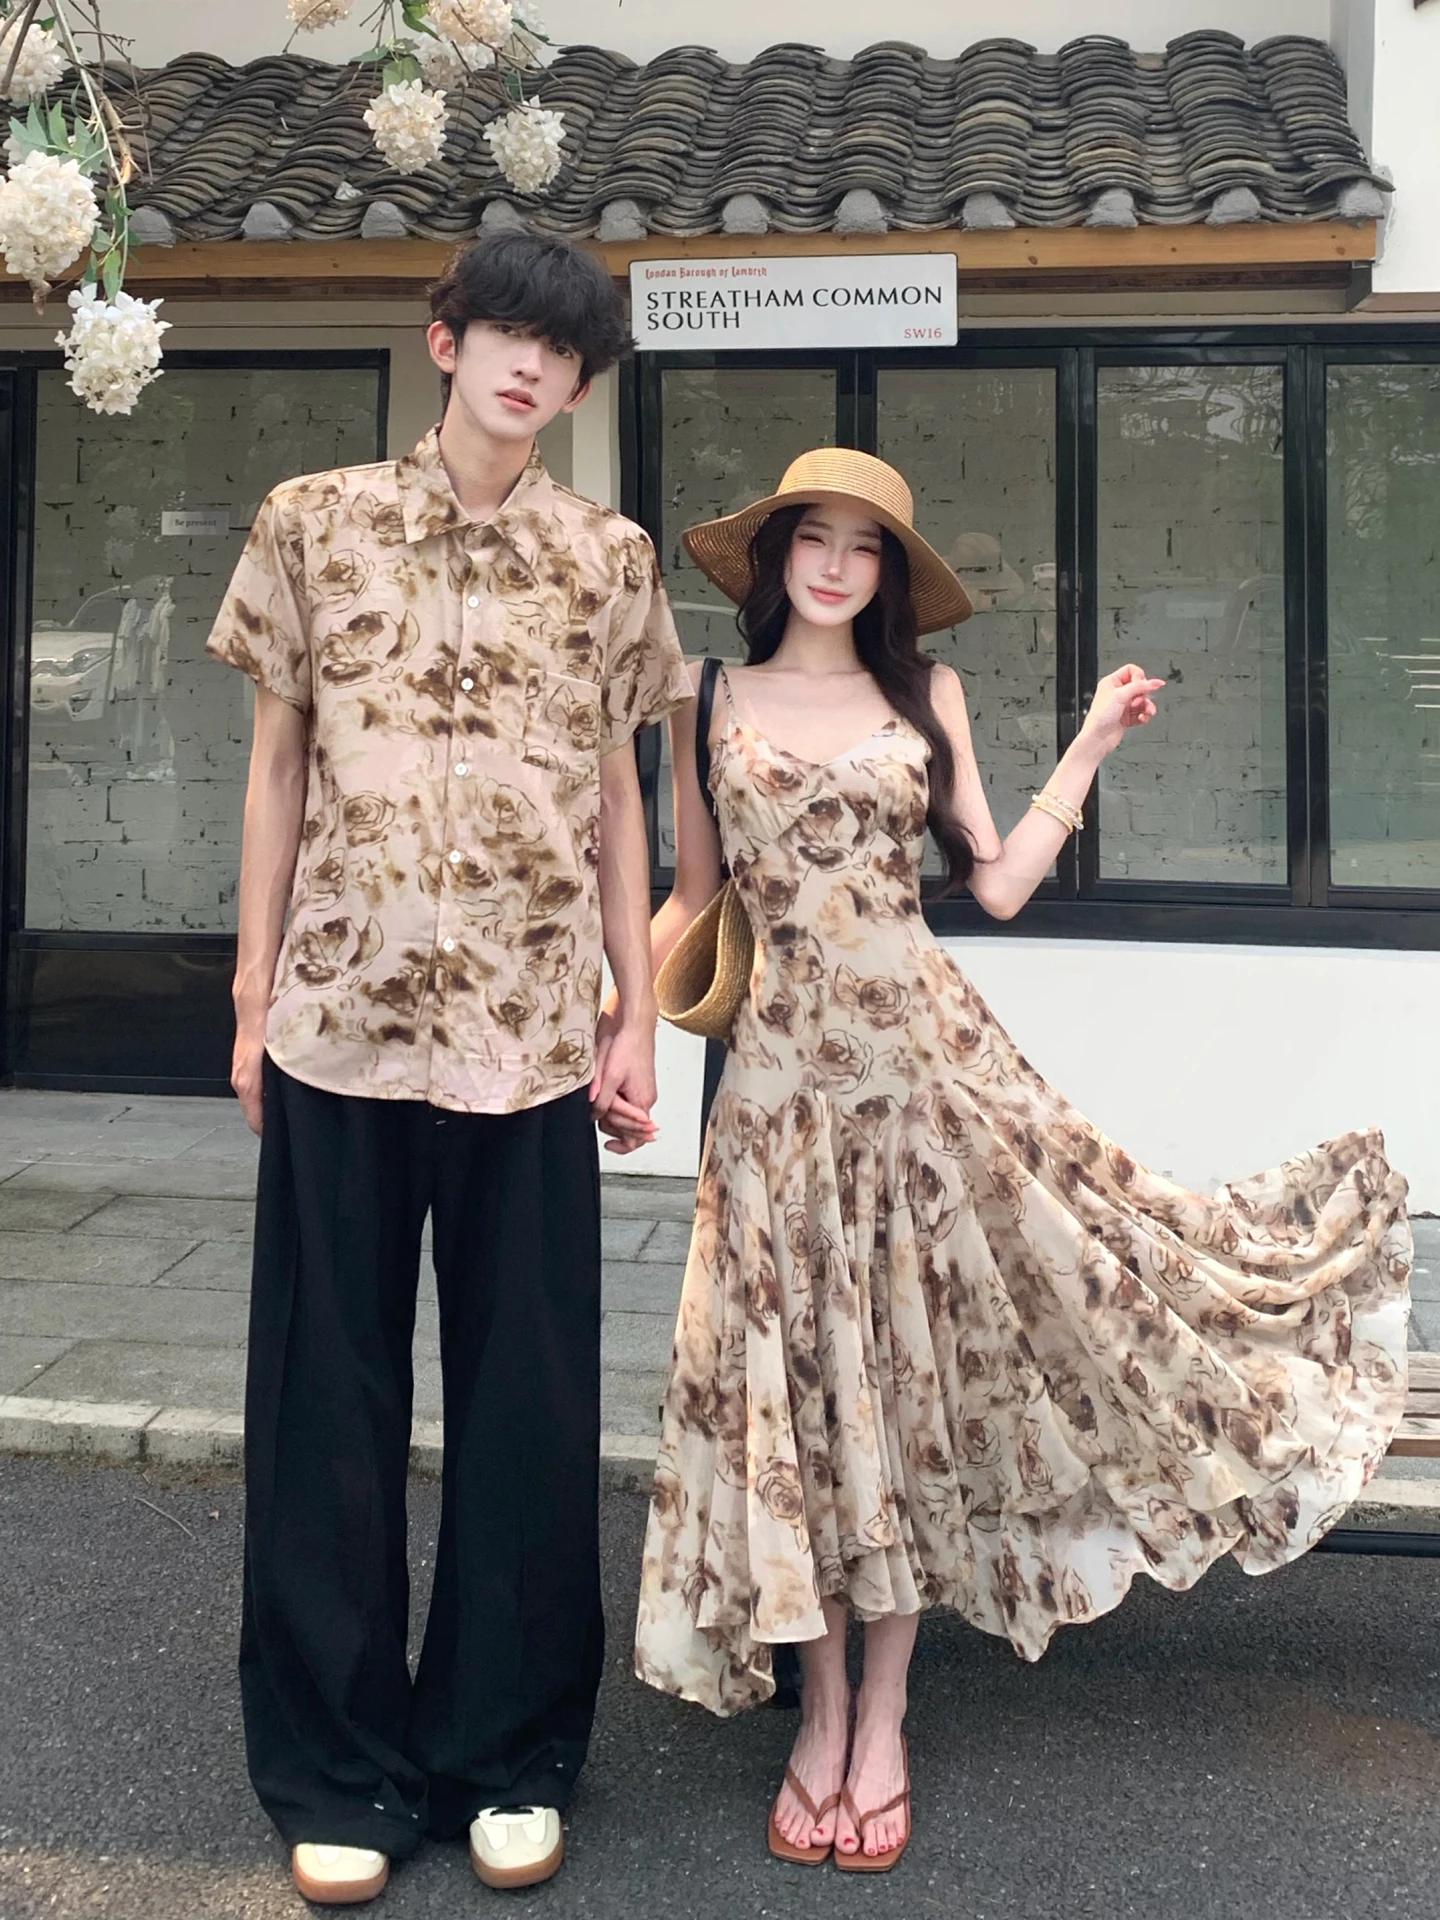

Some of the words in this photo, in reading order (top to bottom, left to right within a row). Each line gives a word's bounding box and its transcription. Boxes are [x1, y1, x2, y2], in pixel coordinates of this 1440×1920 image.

[647, 289, 803, 310] STREATHAM
[812, 286, 942, 307] COMMON
[647, 311, 740, 330] SOUTH
[904, 328, 942, 339] SW16
[186, 519, 216, 527] present
